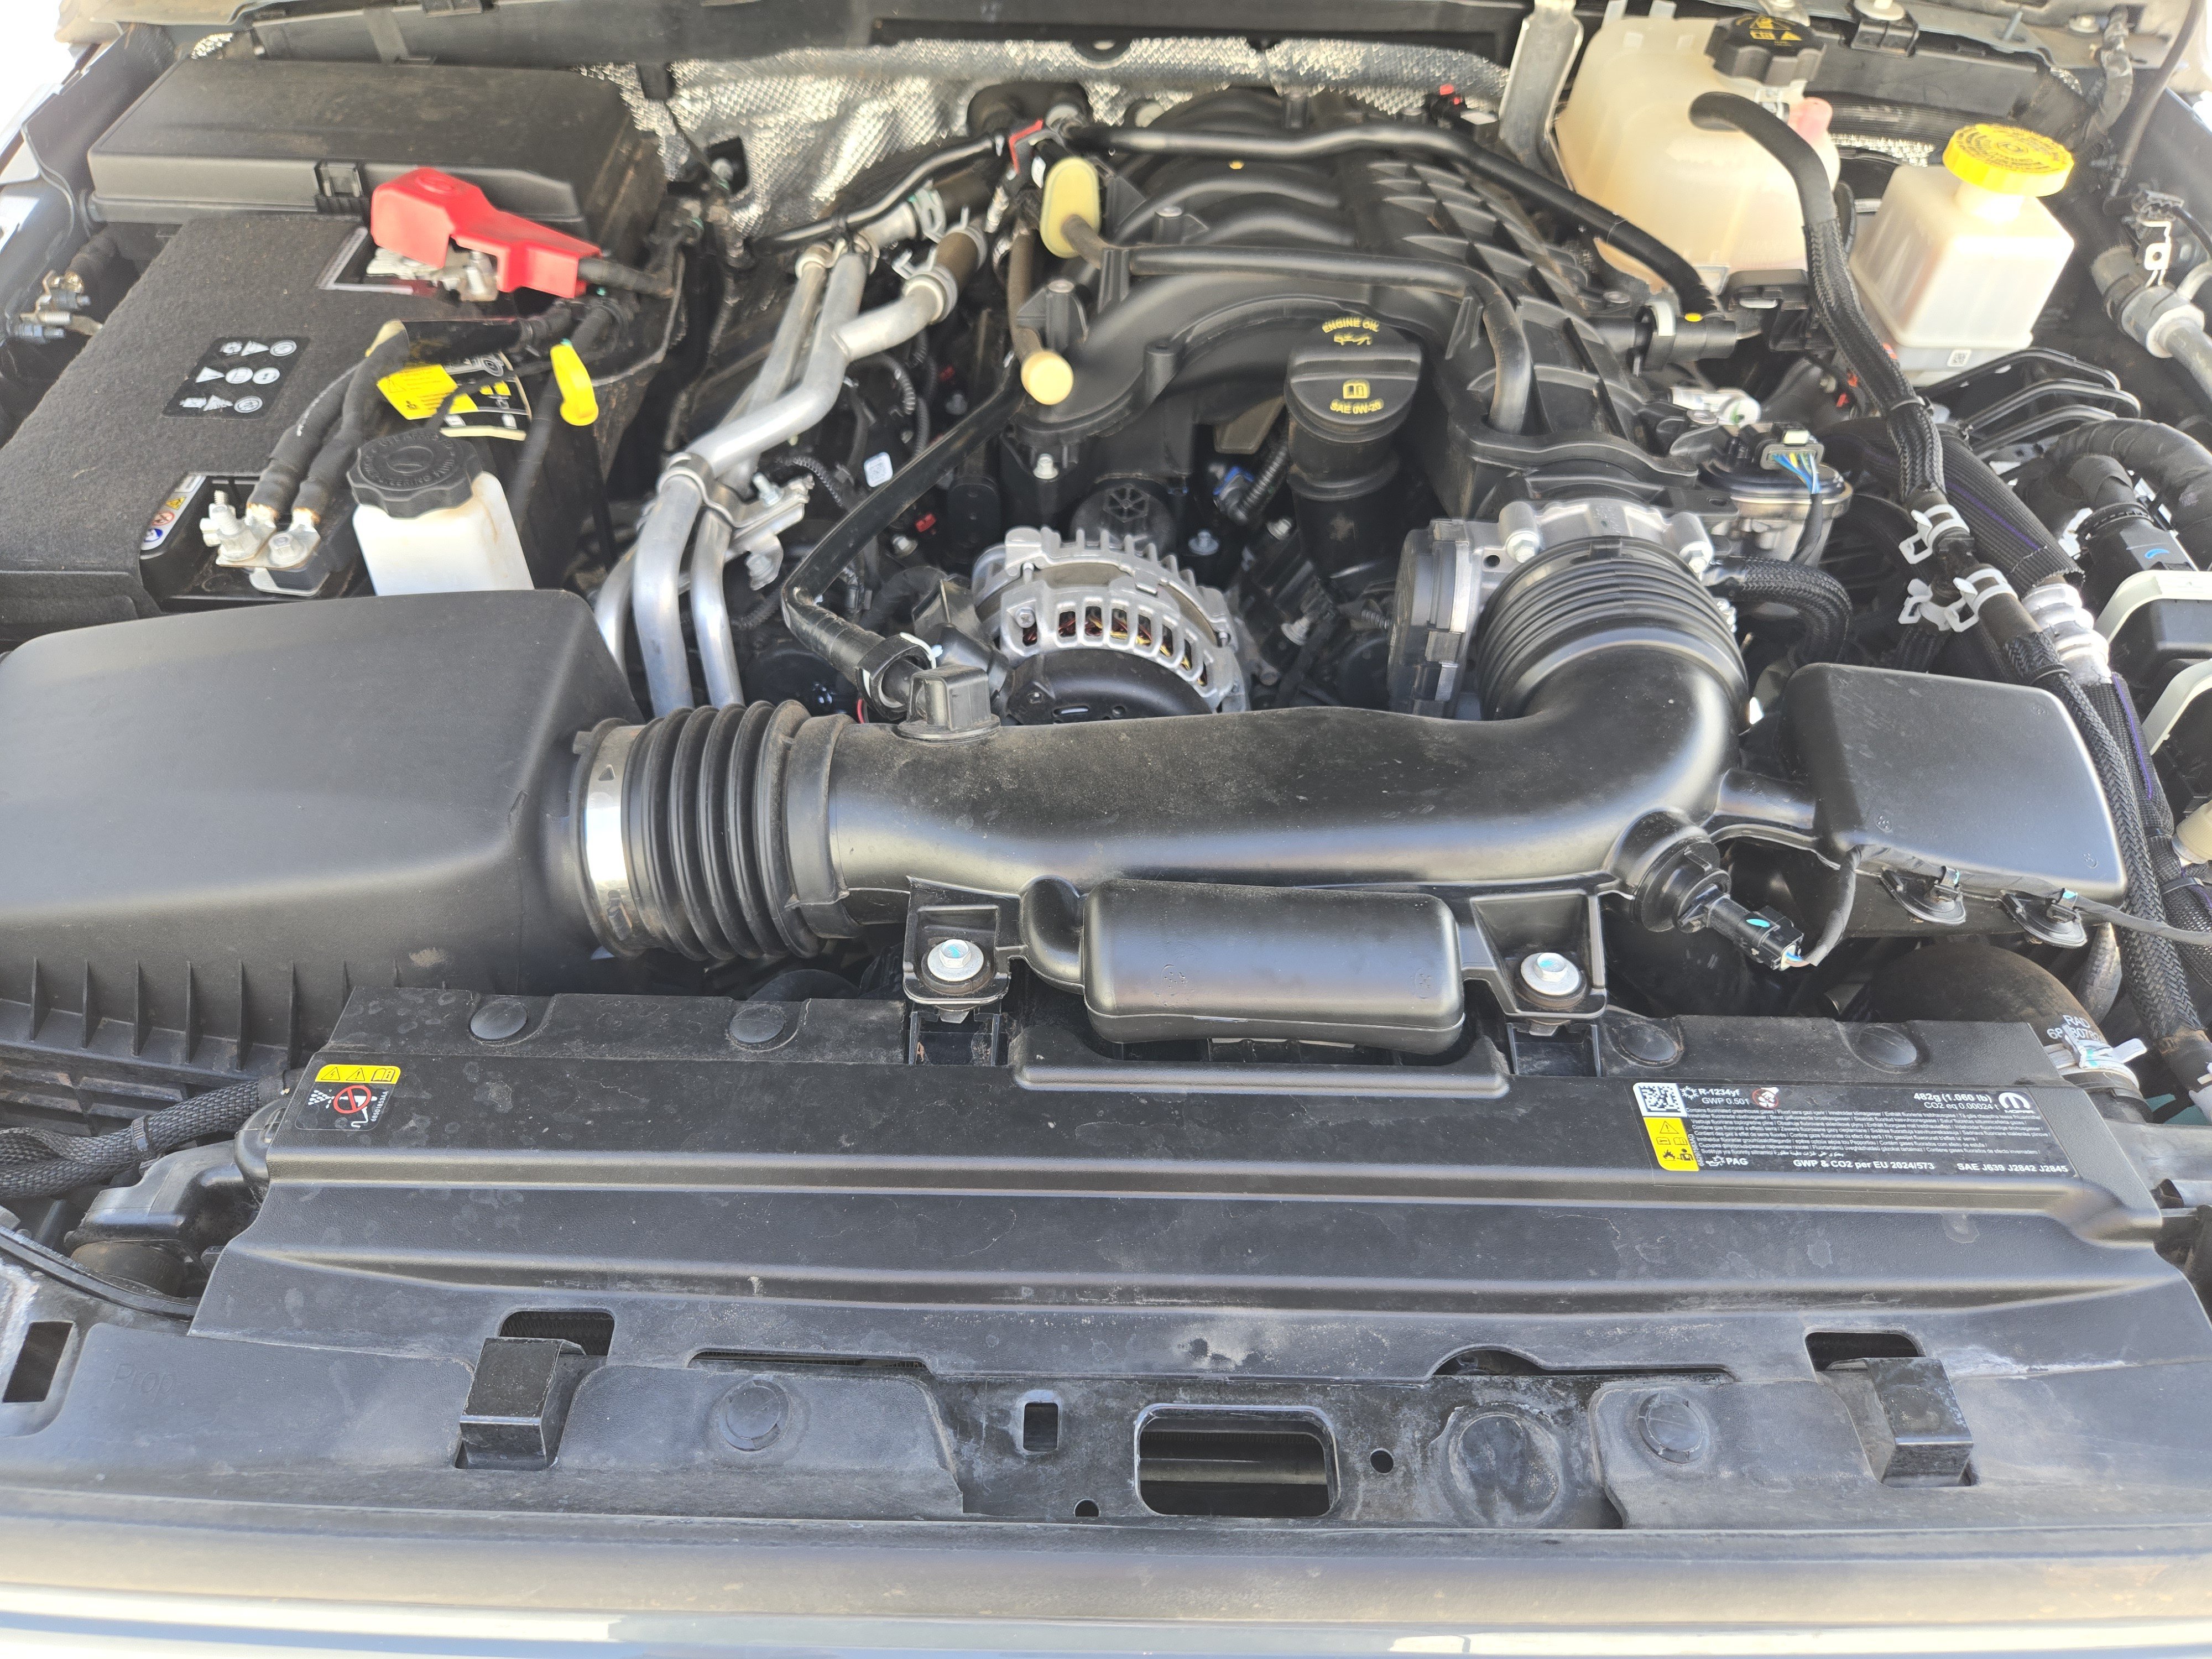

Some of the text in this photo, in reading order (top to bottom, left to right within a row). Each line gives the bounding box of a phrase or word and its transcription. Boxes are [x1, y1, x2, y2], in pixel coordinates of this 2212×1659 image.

[1322, 318, 1381, 333] ENGINE OIL
[1330, 398, 1384, 414] SAE 0W-20
[2063, 1015, 2090, 1028] RAD
[1914, 1093, 1940, 1102] 482g
